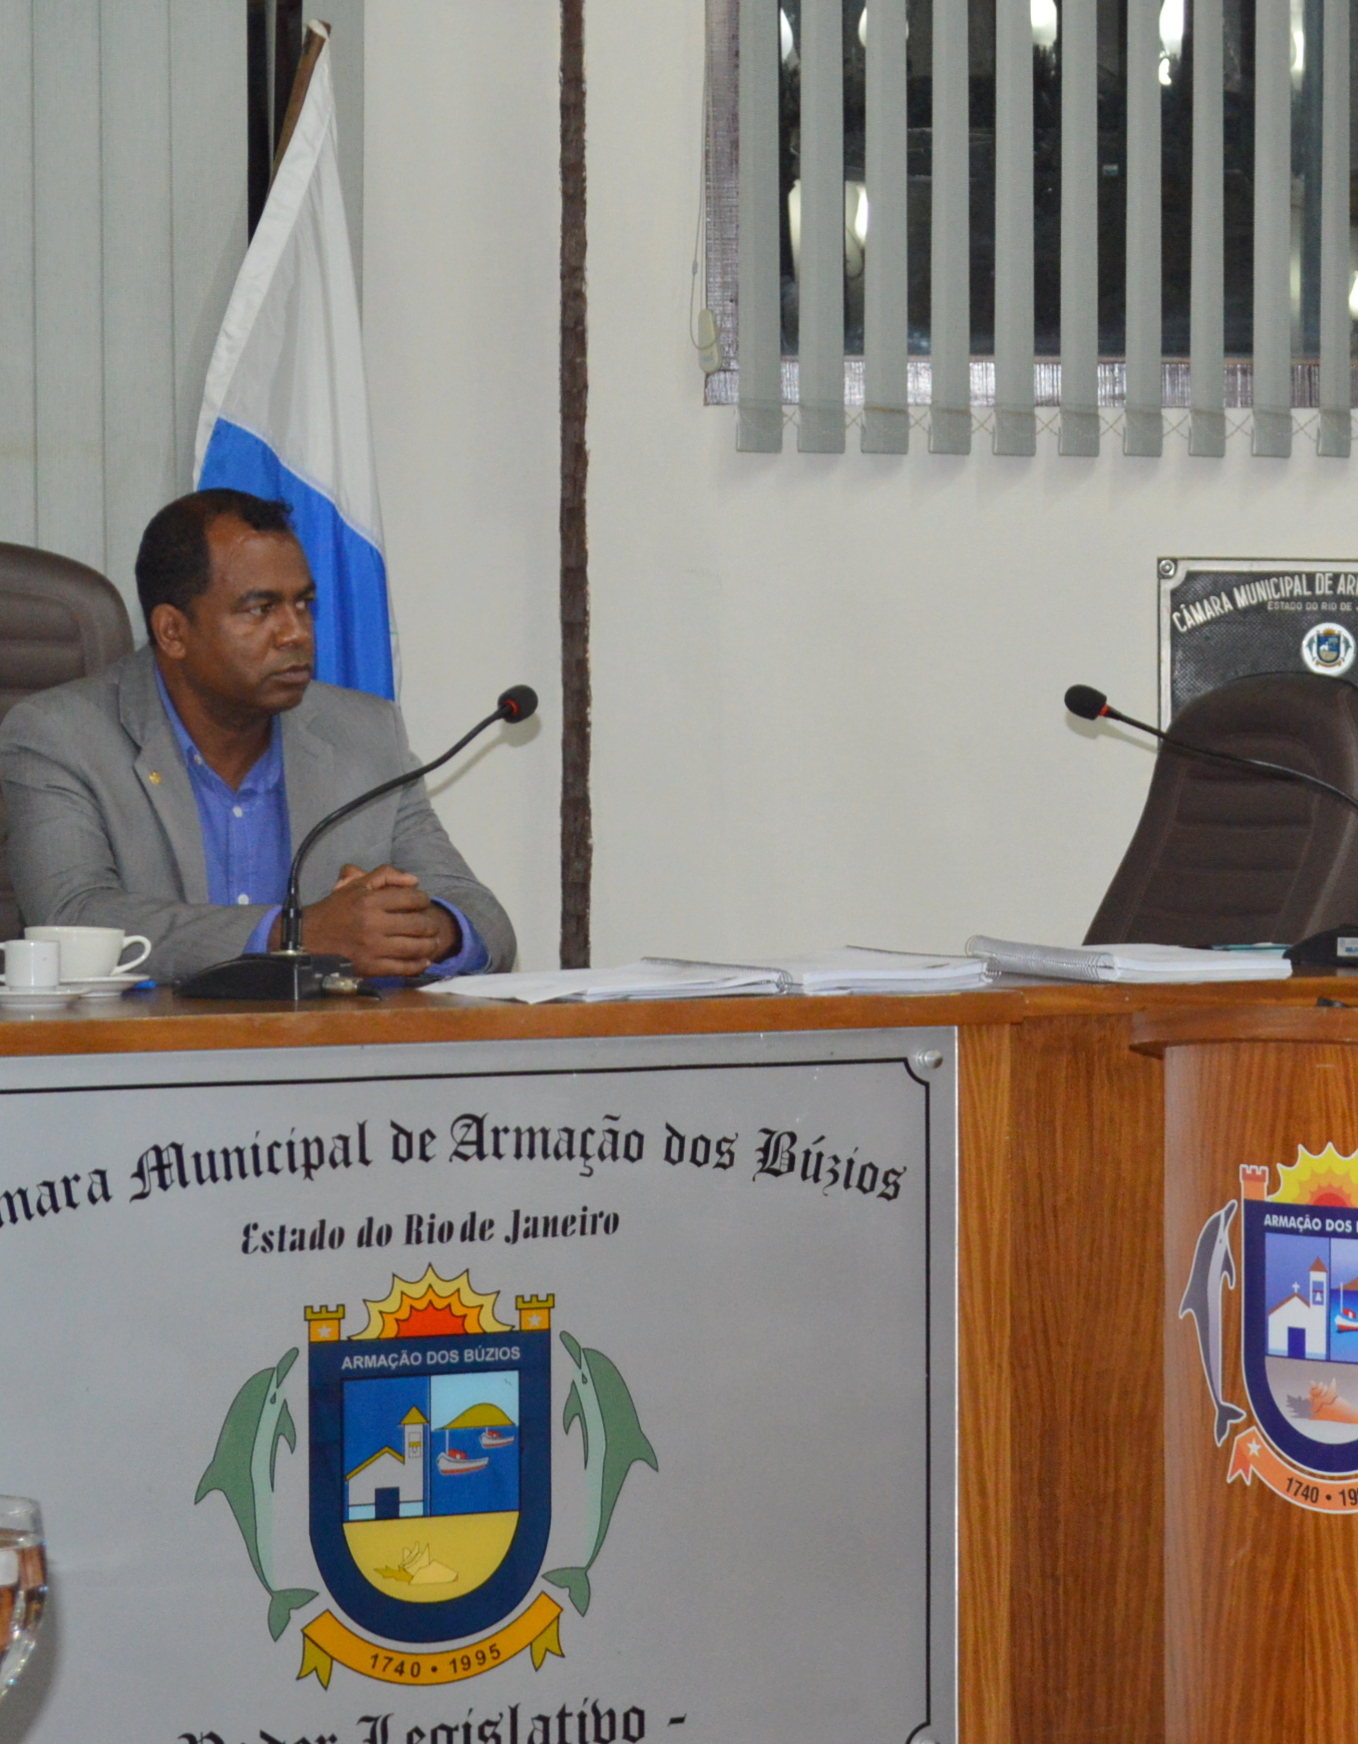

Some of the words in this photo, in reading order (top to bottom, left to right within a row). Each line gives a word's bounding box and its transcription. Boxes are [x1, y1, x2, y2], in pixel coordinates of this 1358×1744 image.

[1172, 591, 1233, 633] CÂMARA
[1233, 574, 1312, 609] MUNICIPAL
[1315, 572, 1334, 595] DE
[1267, 601, 1303, 611] ESTADO
[1305, 601, 1319, 611] DO
[1321, 601, 1338, 611] RIO
[1340, 602, 1352, 611] DE
[129, 1119, 373, 1204] Municipal
[390, 1119, 438, 1165] de
[448, 1112, 645, 1178] Armação
[662, 1121, 739, 1171] dos
[752, 1127, 908, 1202] Búzios
[241, 1218, 345, 1255] Estado
[356, 1216, 393, 1250] do
[404, 1212, 454, 1246] Rio
[459, 1210, 496, 1243] de
[504, 1205, 620, 1246] Janeiro
[1264, 1213, 1322, 1233] ARMAÇÃO
[1325, 1218, 1353, 1233] DOS
[341, 1350, 422, 1370] ARMAÇÃO
[426, 1349, 460, 1365] DOS
[463, 1345, 521, 1363] BÚZIOS
[1286, 1477, 1320, 1503] 1740
[371, 1653, 421, 1678] 1740
[449, 1643, 501, 1674] 1995
